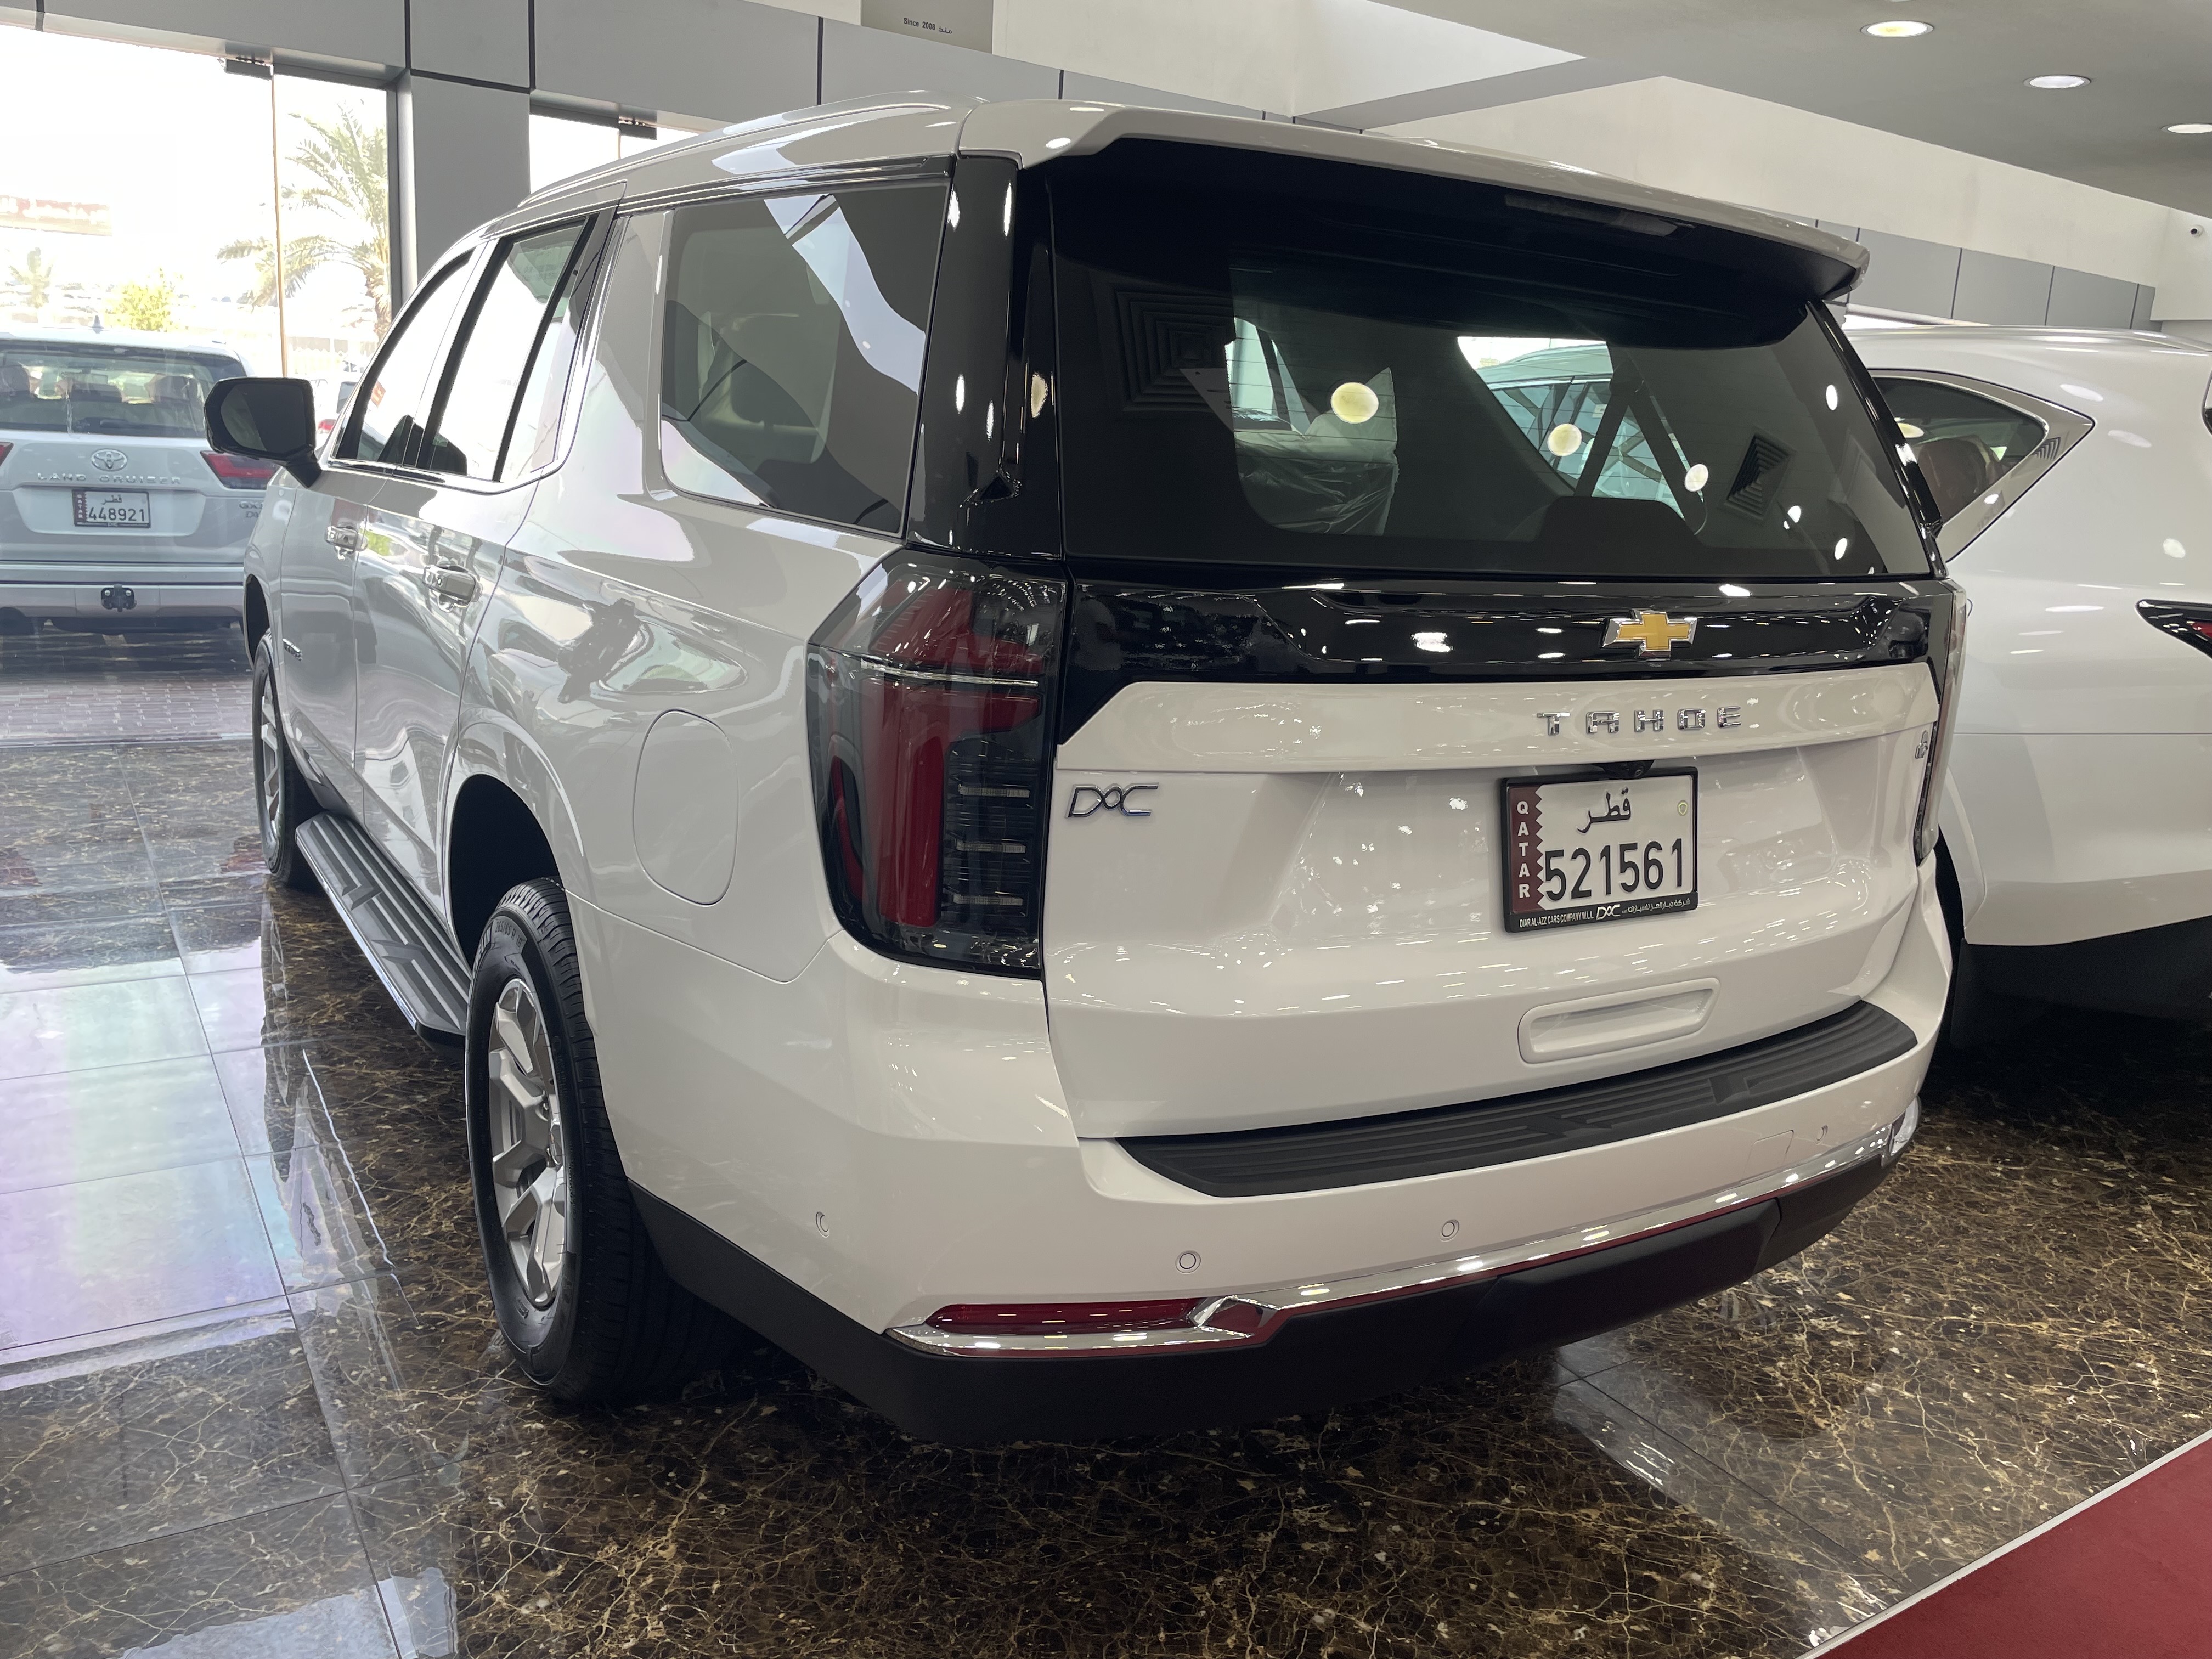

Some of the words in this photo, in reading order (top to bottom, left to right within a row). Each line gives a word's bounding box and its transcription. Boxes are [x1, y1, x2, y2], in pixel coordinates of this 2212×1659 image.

[903, 17, 919, 27] Since
[922, 21, 935, 31] 2008
[938, 26, 952, 35] منذ
[37, 472, 87, 482] LAND
[99, 474, 182, 485] CRUISER
[101, 494, 122, 505] قطر
[88, 507, 145, 522] 448921
[1537, 706, 1742, 736] TAHOE
[1577, 787, 1632, 833] قطر
[1516, 800, 1531, 899] QATAR
[1544, 838, 1683, 901] 521561
[1674, 898, 1691, 907] شركة
[1519, 918, 1531, 928] DIAR
[1531, 916, 1547, 927] AL-AZZ
[1547, 913, 1560, 924] CARS
[1560, 912, 1582, 923] COMPANY
[495, 921, 512, 936] 265/65
[511, 929, 516, 941] R
[516, 934, 522, 949] 18
